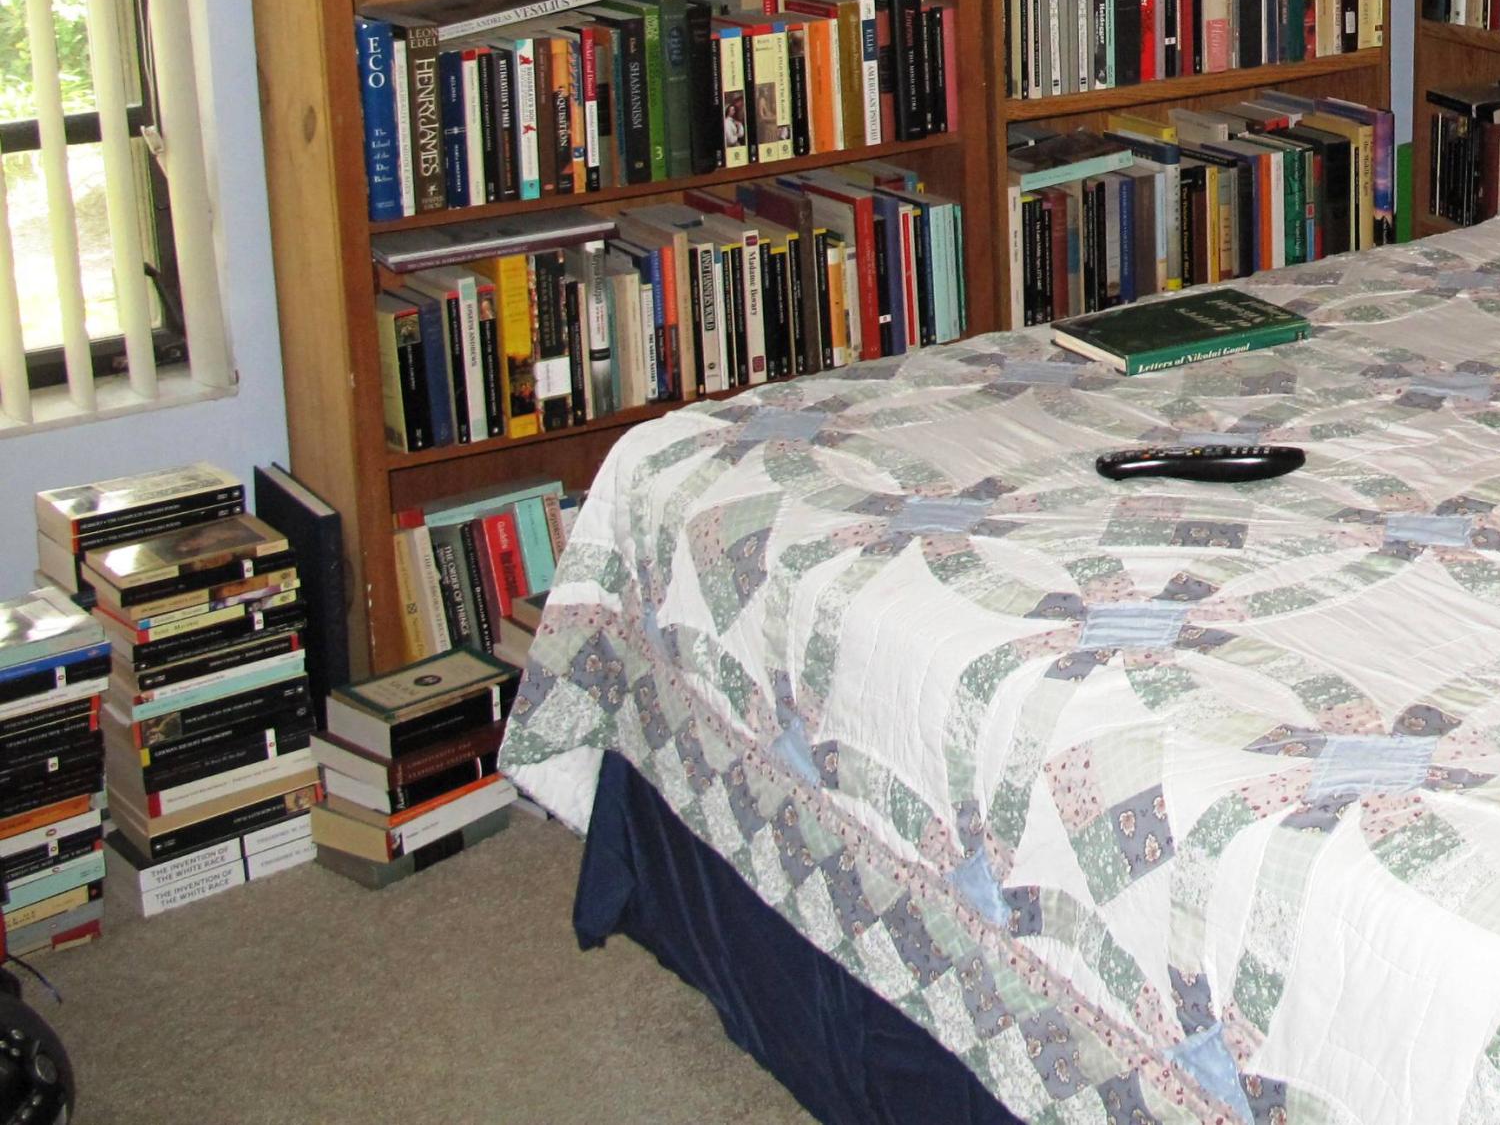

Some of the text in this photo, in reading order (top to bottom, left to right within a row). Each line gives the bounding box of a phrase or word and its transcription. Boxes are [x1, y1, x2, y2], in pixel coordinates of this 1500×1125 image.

[866, 29, 874, 52] ELLIS
[629, 62, 643, 130] SHAMANISM
[867, 64, 876, 108] AMERICAN
[415, 58, 440, 177] HENRY JAMES
[748, 252, 758, 316] Madame Bovary
[1138, 359, 1173, 374] Letters
[1187, 350, 1222, 364] Nikolai
[444, 546, 469, 635] THE ORDER OF THINGS
[151, 846, 228, 877] THE INVENTION OF
[157, 856, 225, 883] THE WHITE RACE
[161, 879, 229, 906] THE WHITE RACE
[174, 874, 221, 894] INVENTION
[223, 869, 232, 877] OF
